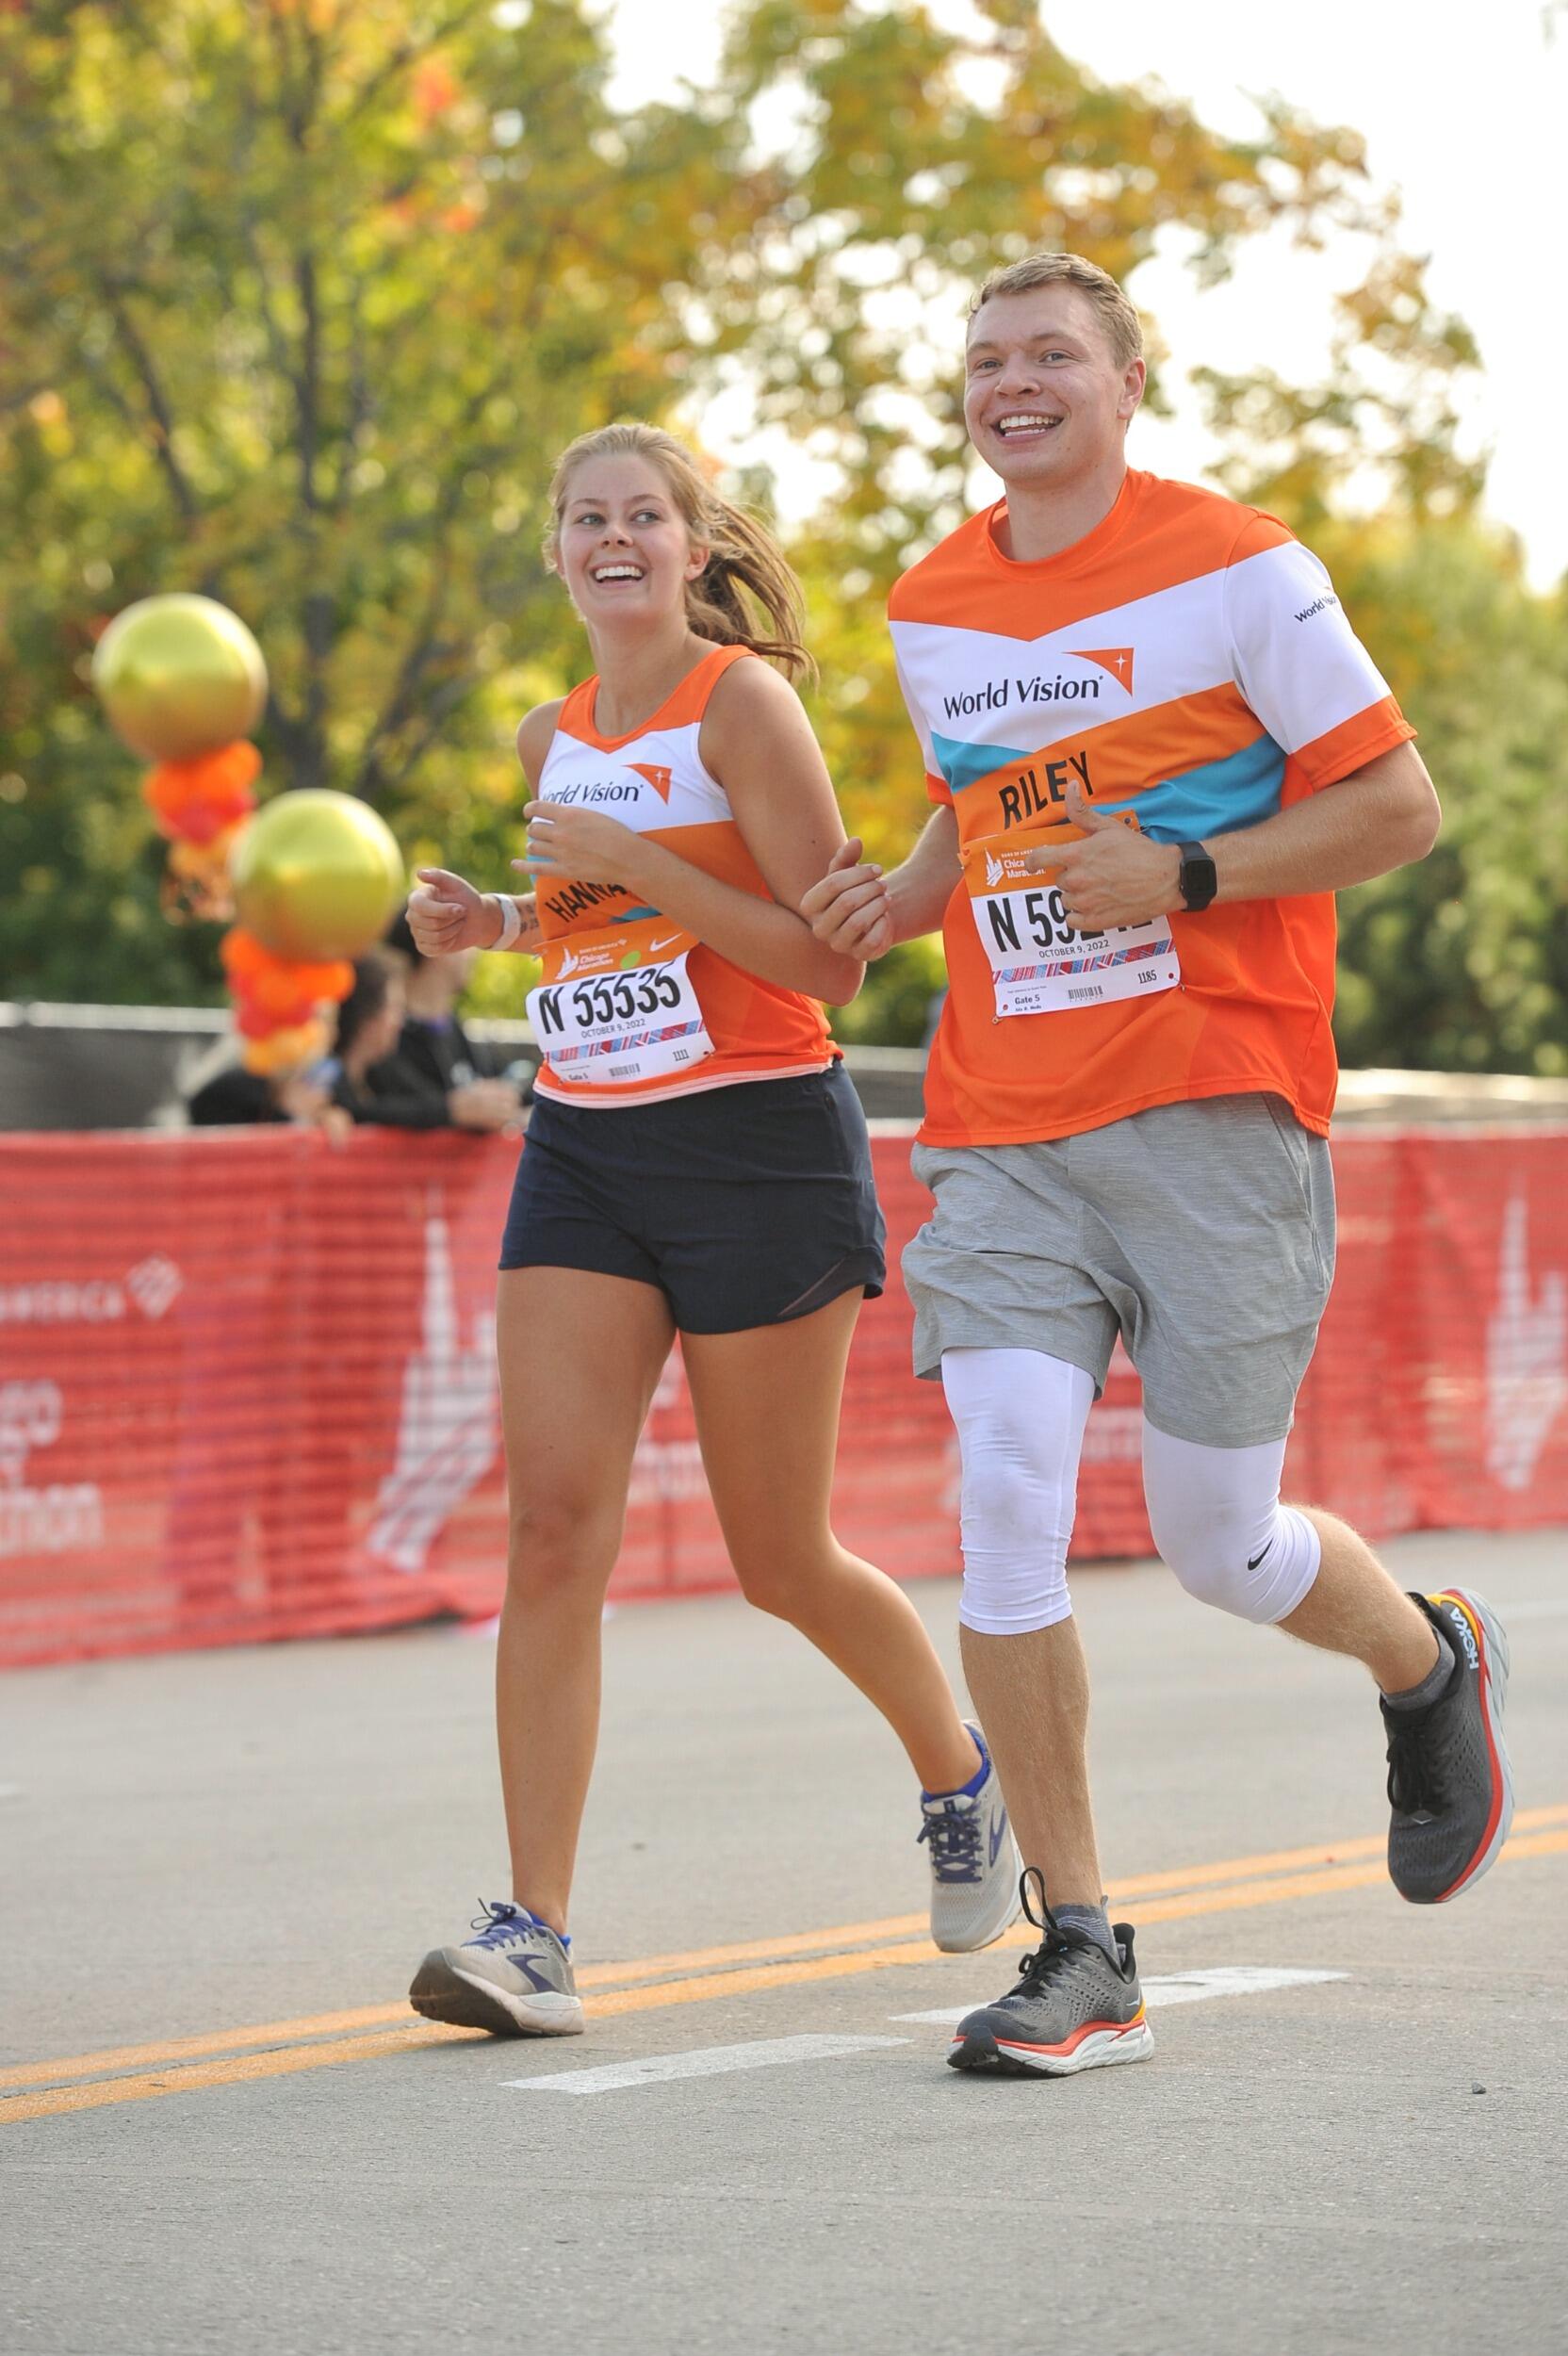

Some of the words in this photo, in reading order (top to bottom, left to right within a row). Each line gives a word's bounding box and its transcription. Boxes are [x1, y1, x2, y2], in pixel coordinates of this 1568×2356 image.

[1294, 597, 1326, 623] World
[943, 679, 1008, 720] World
[1016, 675, 1099, 703] Vision
[582, 781, 639, 802] Vision
[998, 751, 1093, 830] RILEY
[987, 897, 1021, 953] N
[1038, 946, 1075, 958] OCTOBER
[1077, 945, 1086, 954] 9,
[1087, 939, 1110, 951] 2022
[1137, 969, 1157, 984] 1185
[539, 987, 565, 1035] N
[573, 958, 681, 1027] 55535
[1015, 996, 1033, 1005] Gate
[1035, 993, 1040, 1002] 5
[580, 1024, 615, 1039] OCTOBER
[626, 1018, 645, 1029] 2022
[1450, 1607, 1479, 1669] HOKA
